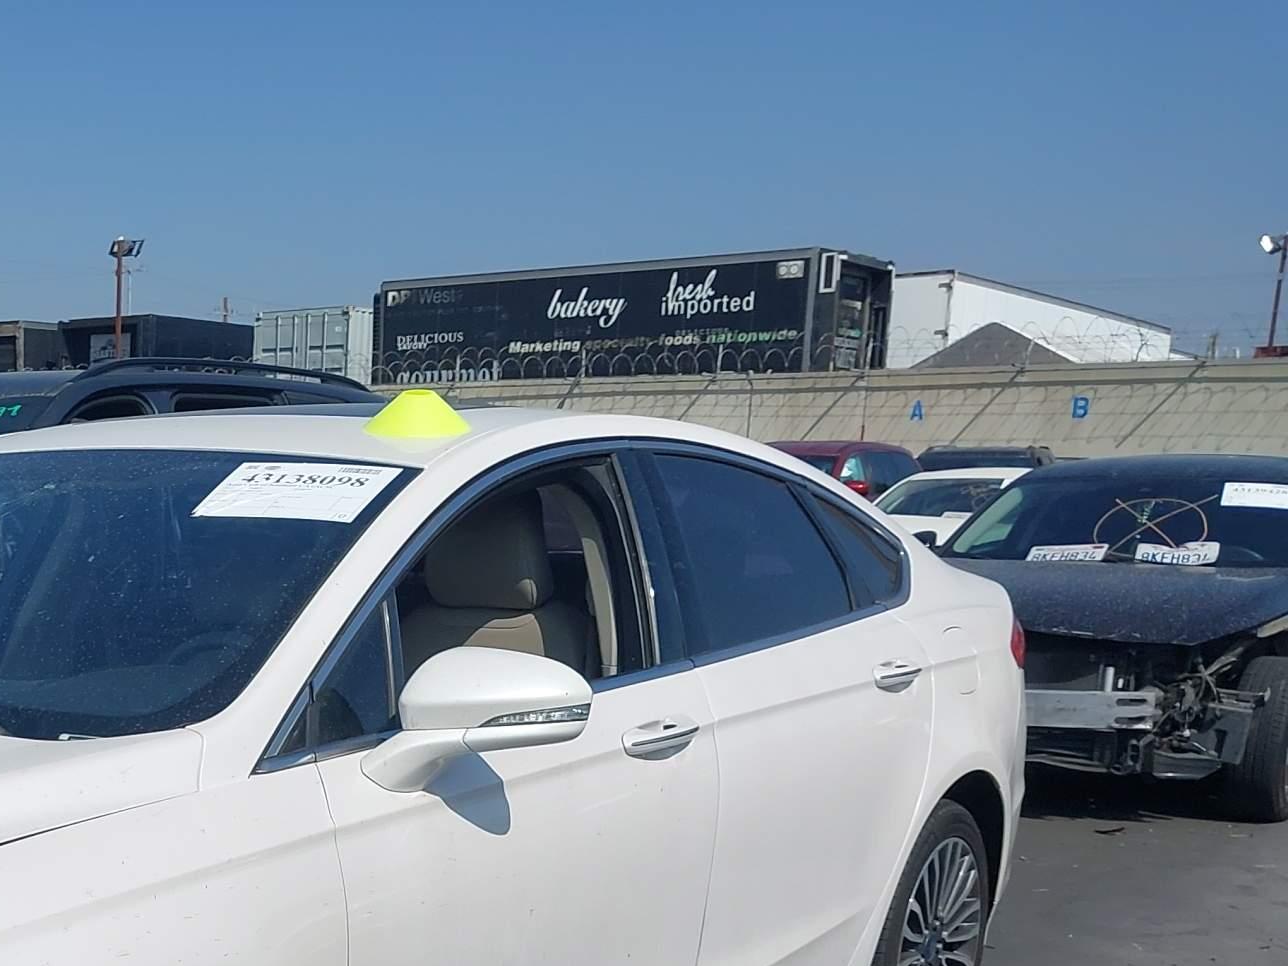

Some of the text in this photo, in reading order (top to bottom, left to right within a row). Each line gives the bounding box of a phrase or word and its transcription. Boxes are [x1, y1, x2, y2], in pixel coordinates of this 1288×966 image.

[546, 286, 628, 328] bakery
[661, 290, 756, 319] imported
[508, 338, 582, 354] Marketing
[704, 328, 798, 344] nationwide
[910, 400, 924, 420] A
[1072, 397, 1089, 418] B
[242, 472, 370, 488] 43138098
